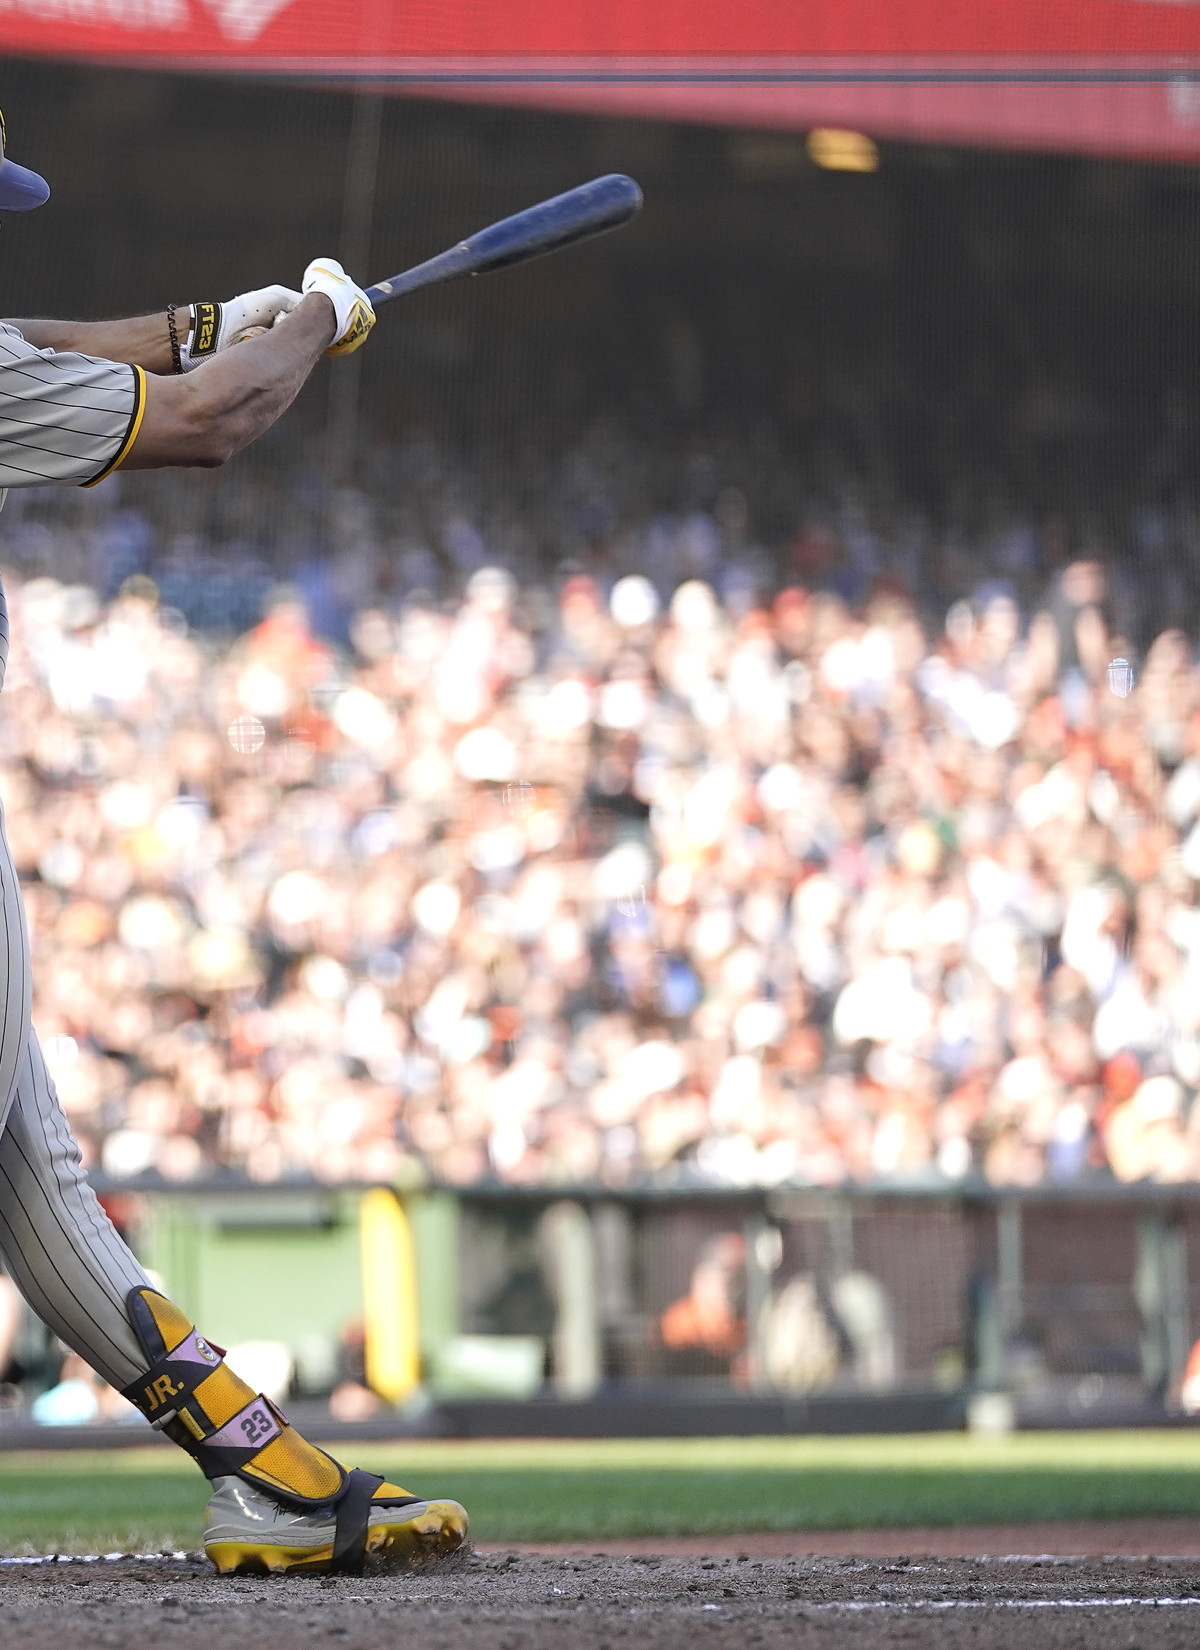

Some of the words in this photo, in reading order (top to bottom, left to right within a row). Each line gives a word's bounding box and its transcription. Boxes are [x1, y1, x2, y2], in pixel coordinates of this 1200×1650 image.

[199, 304, 215, 350] FT23
[144, 1374, 184, 1411] JR.
[240, 1409, 273, 1444] 23
